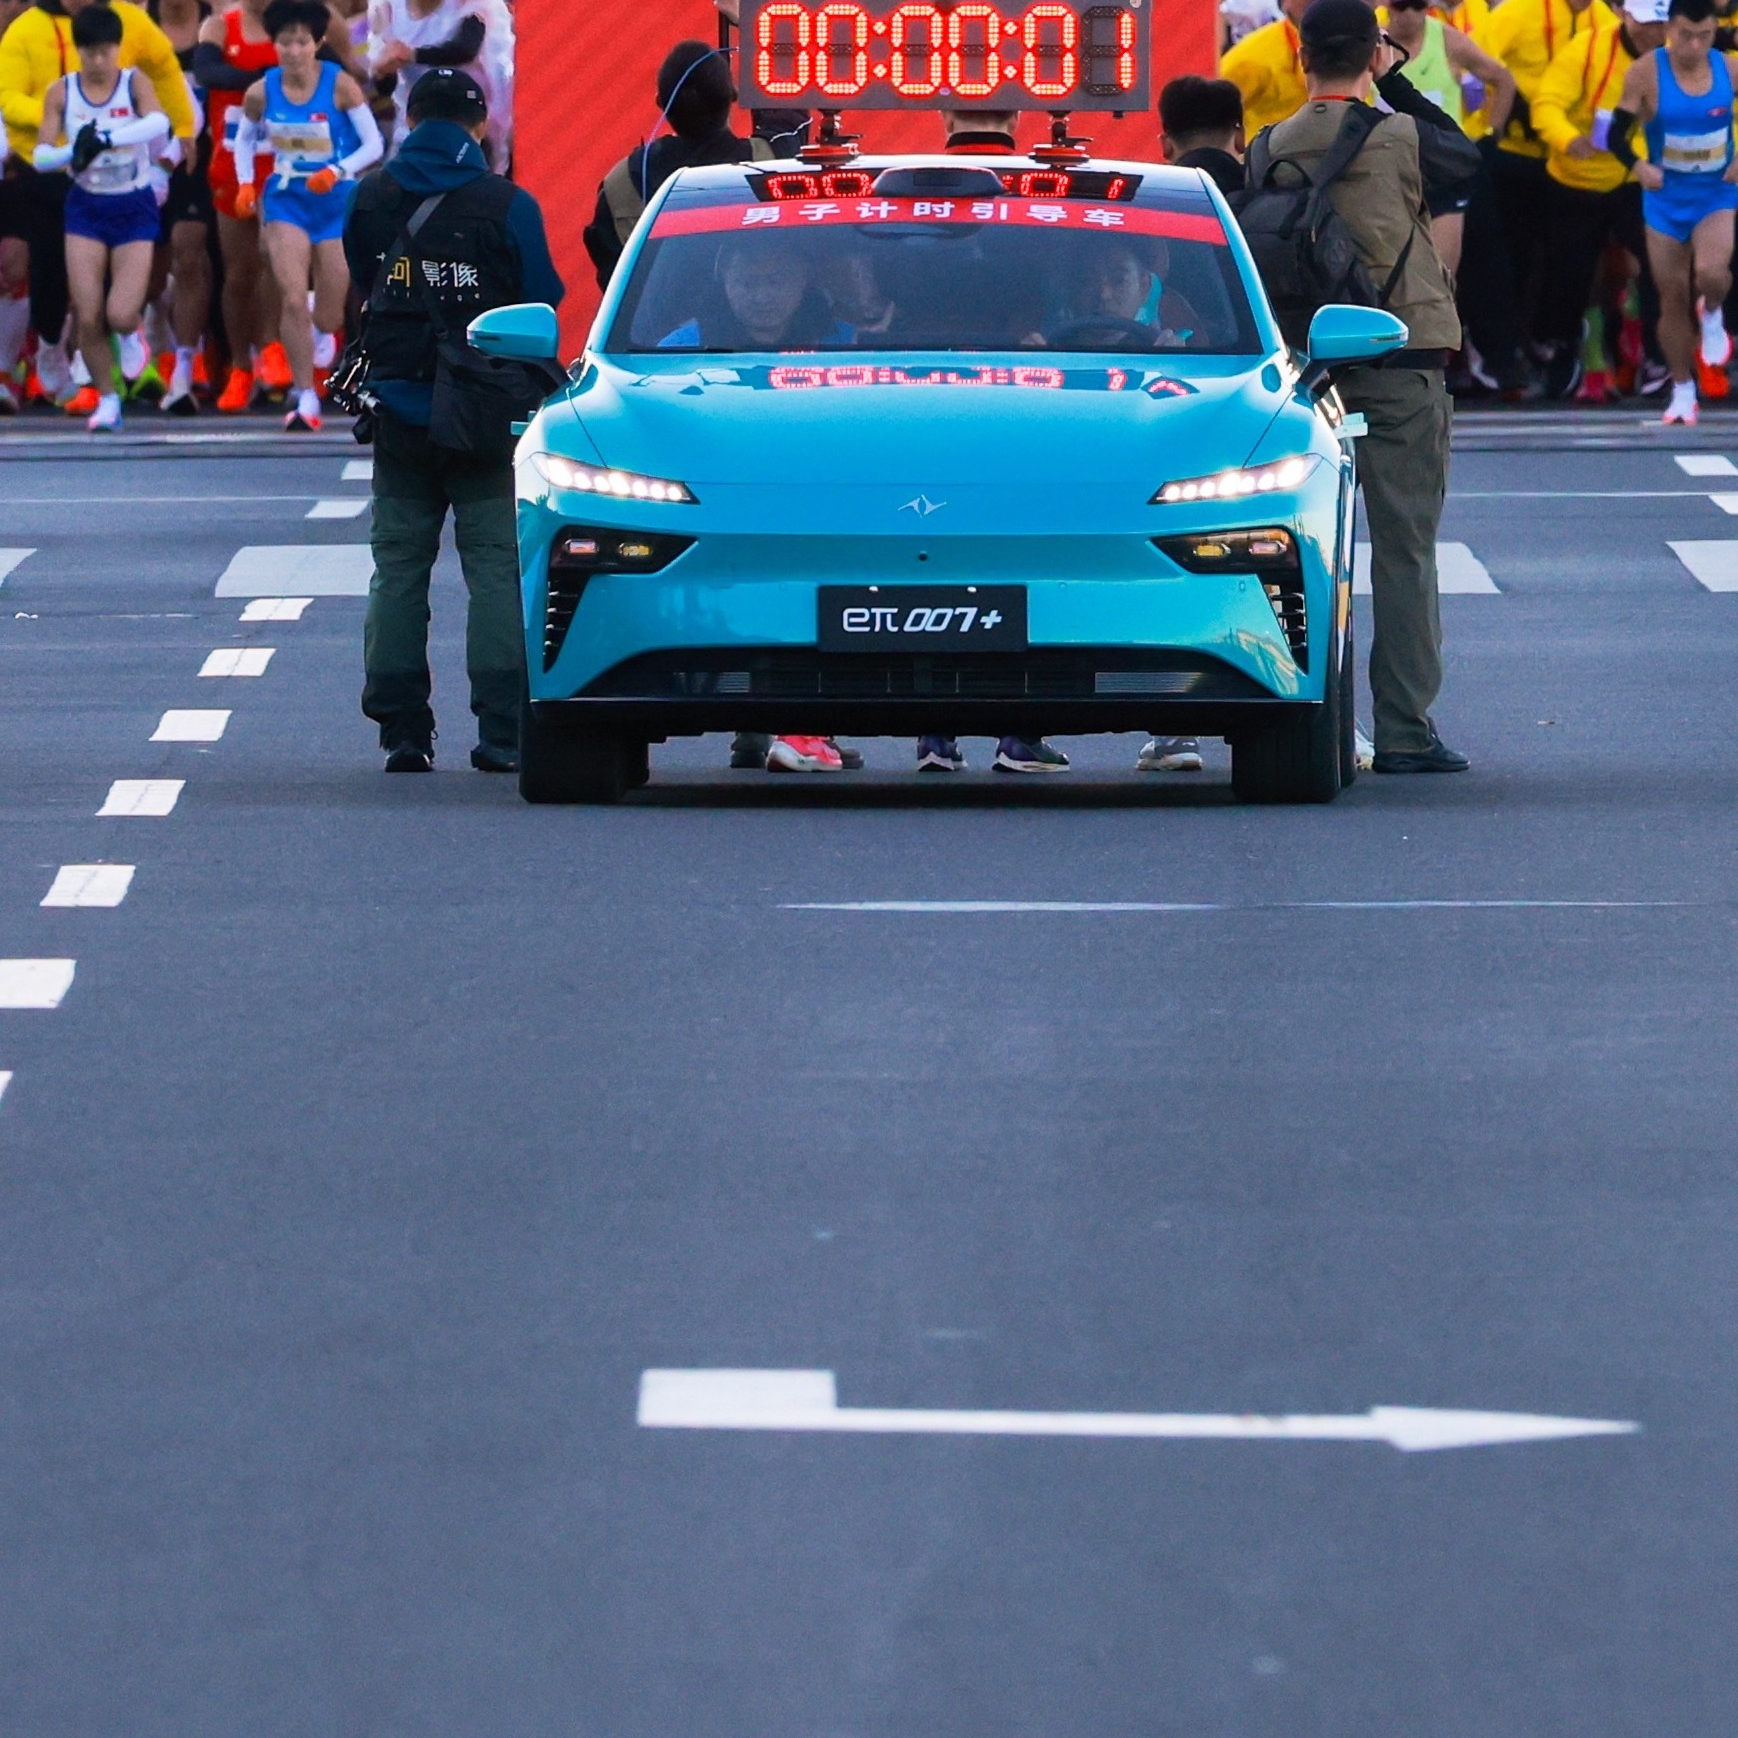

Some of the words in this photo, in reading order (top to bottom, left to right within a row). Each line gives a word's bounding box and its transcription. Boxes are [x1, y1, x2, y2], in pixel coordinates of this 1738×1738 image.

[754, 0, 1138, 97] 00:00:01
[741, 201, 1125, 227] 男子计时引导车
